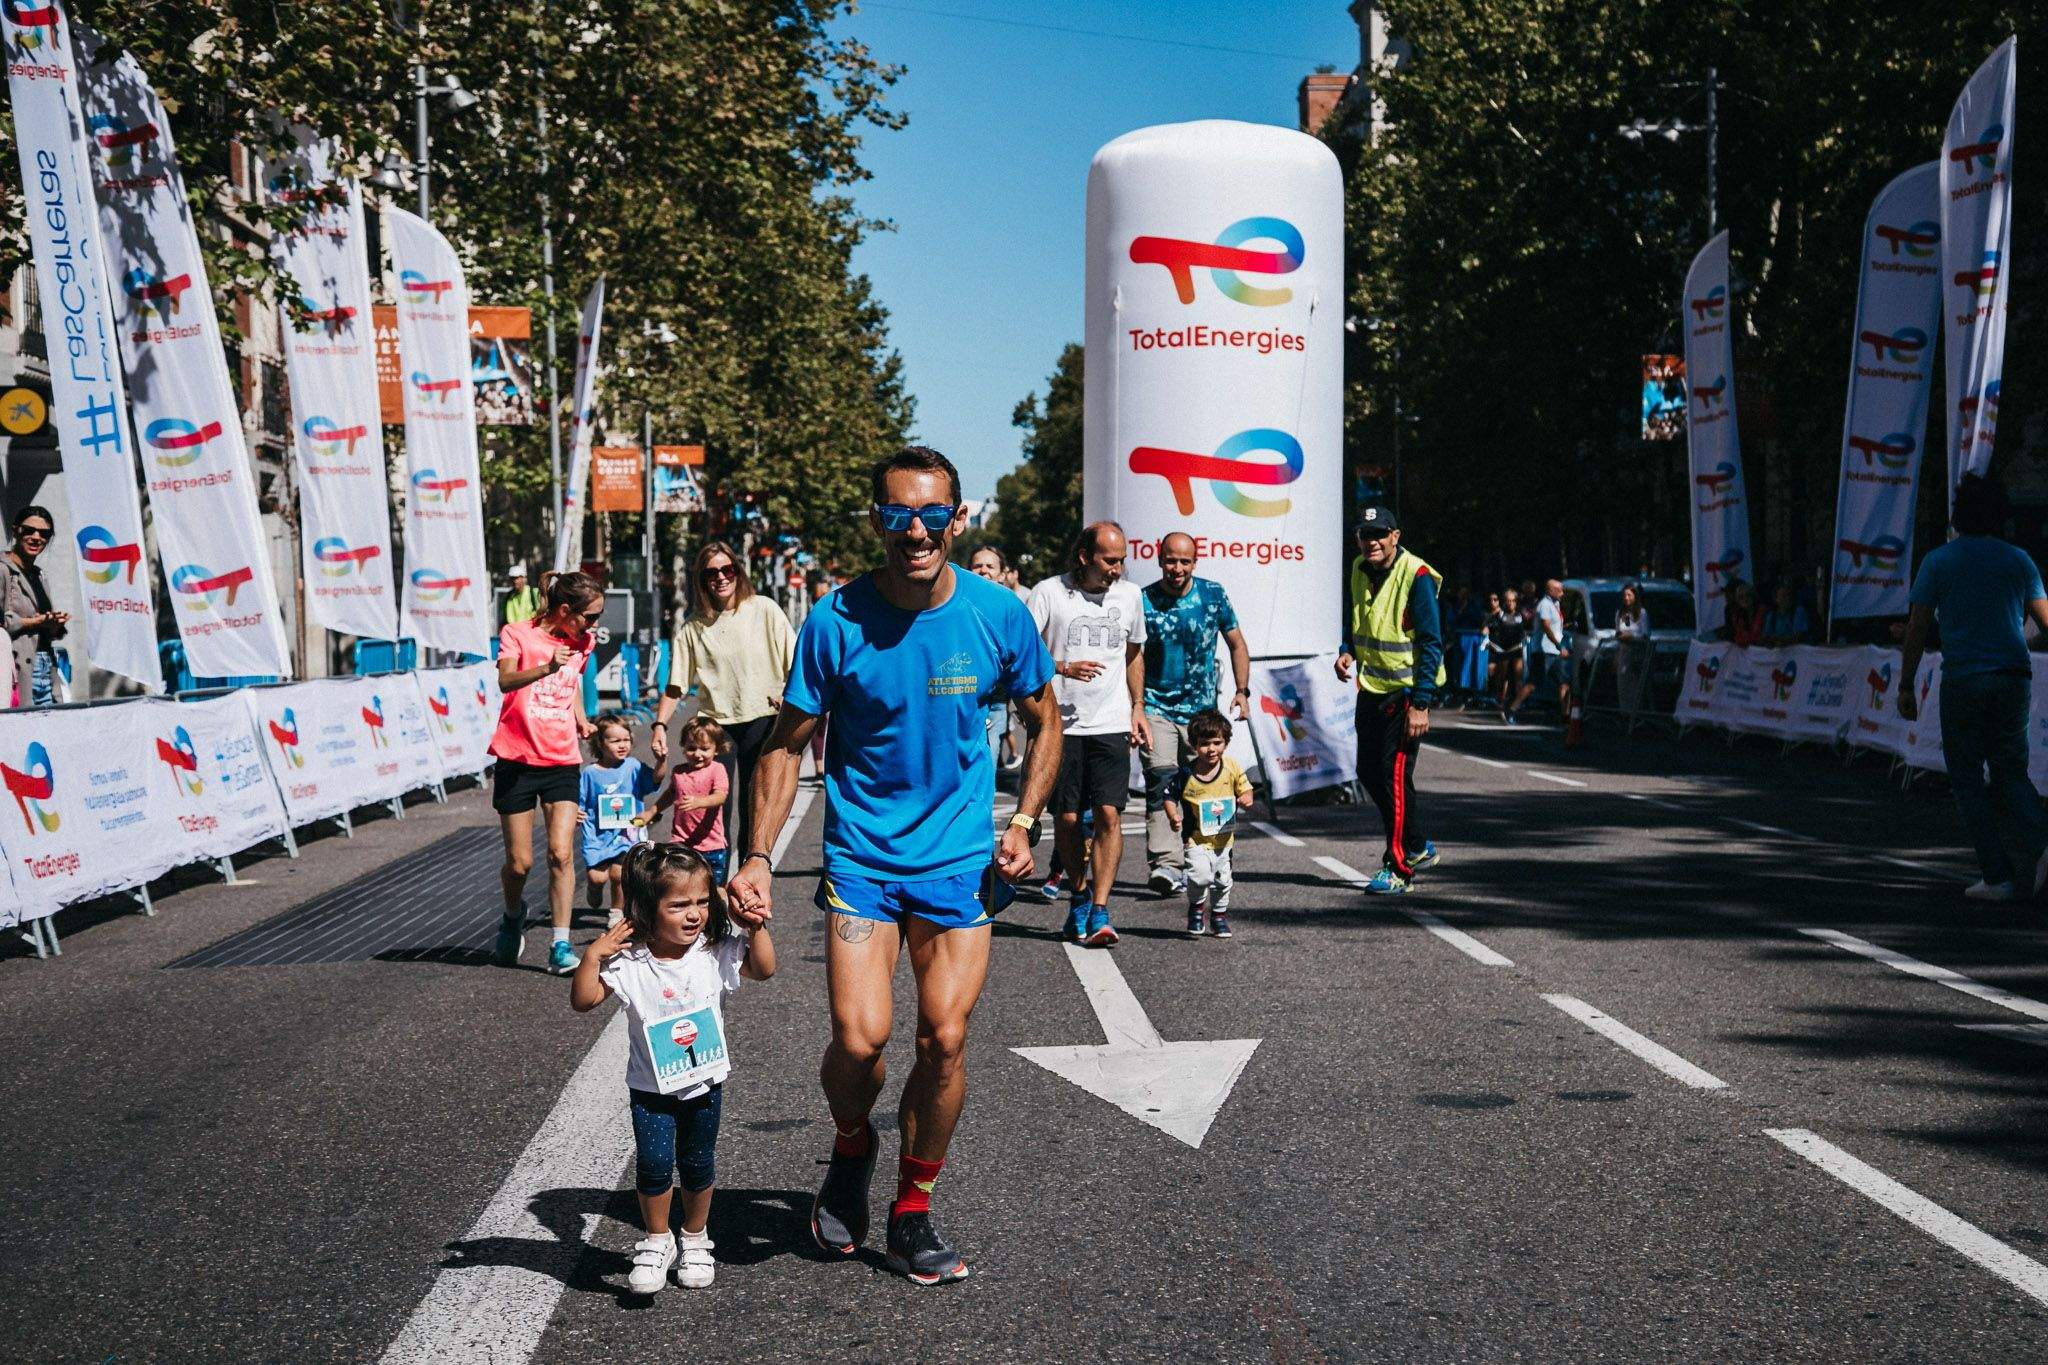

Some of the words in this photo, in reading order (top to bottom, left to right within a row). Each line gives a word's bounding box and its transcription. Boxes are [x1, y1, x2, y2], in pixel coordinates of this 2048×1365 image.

[1129, 326, 1305, 354] TotalEnergies
[1365, 508, 1377, 520] S
[1129, 536, 1305, 565] TotEnergies
[928, 675, 977, 686] ATLETISMO
[684, 1045, 698, 1068] 1
